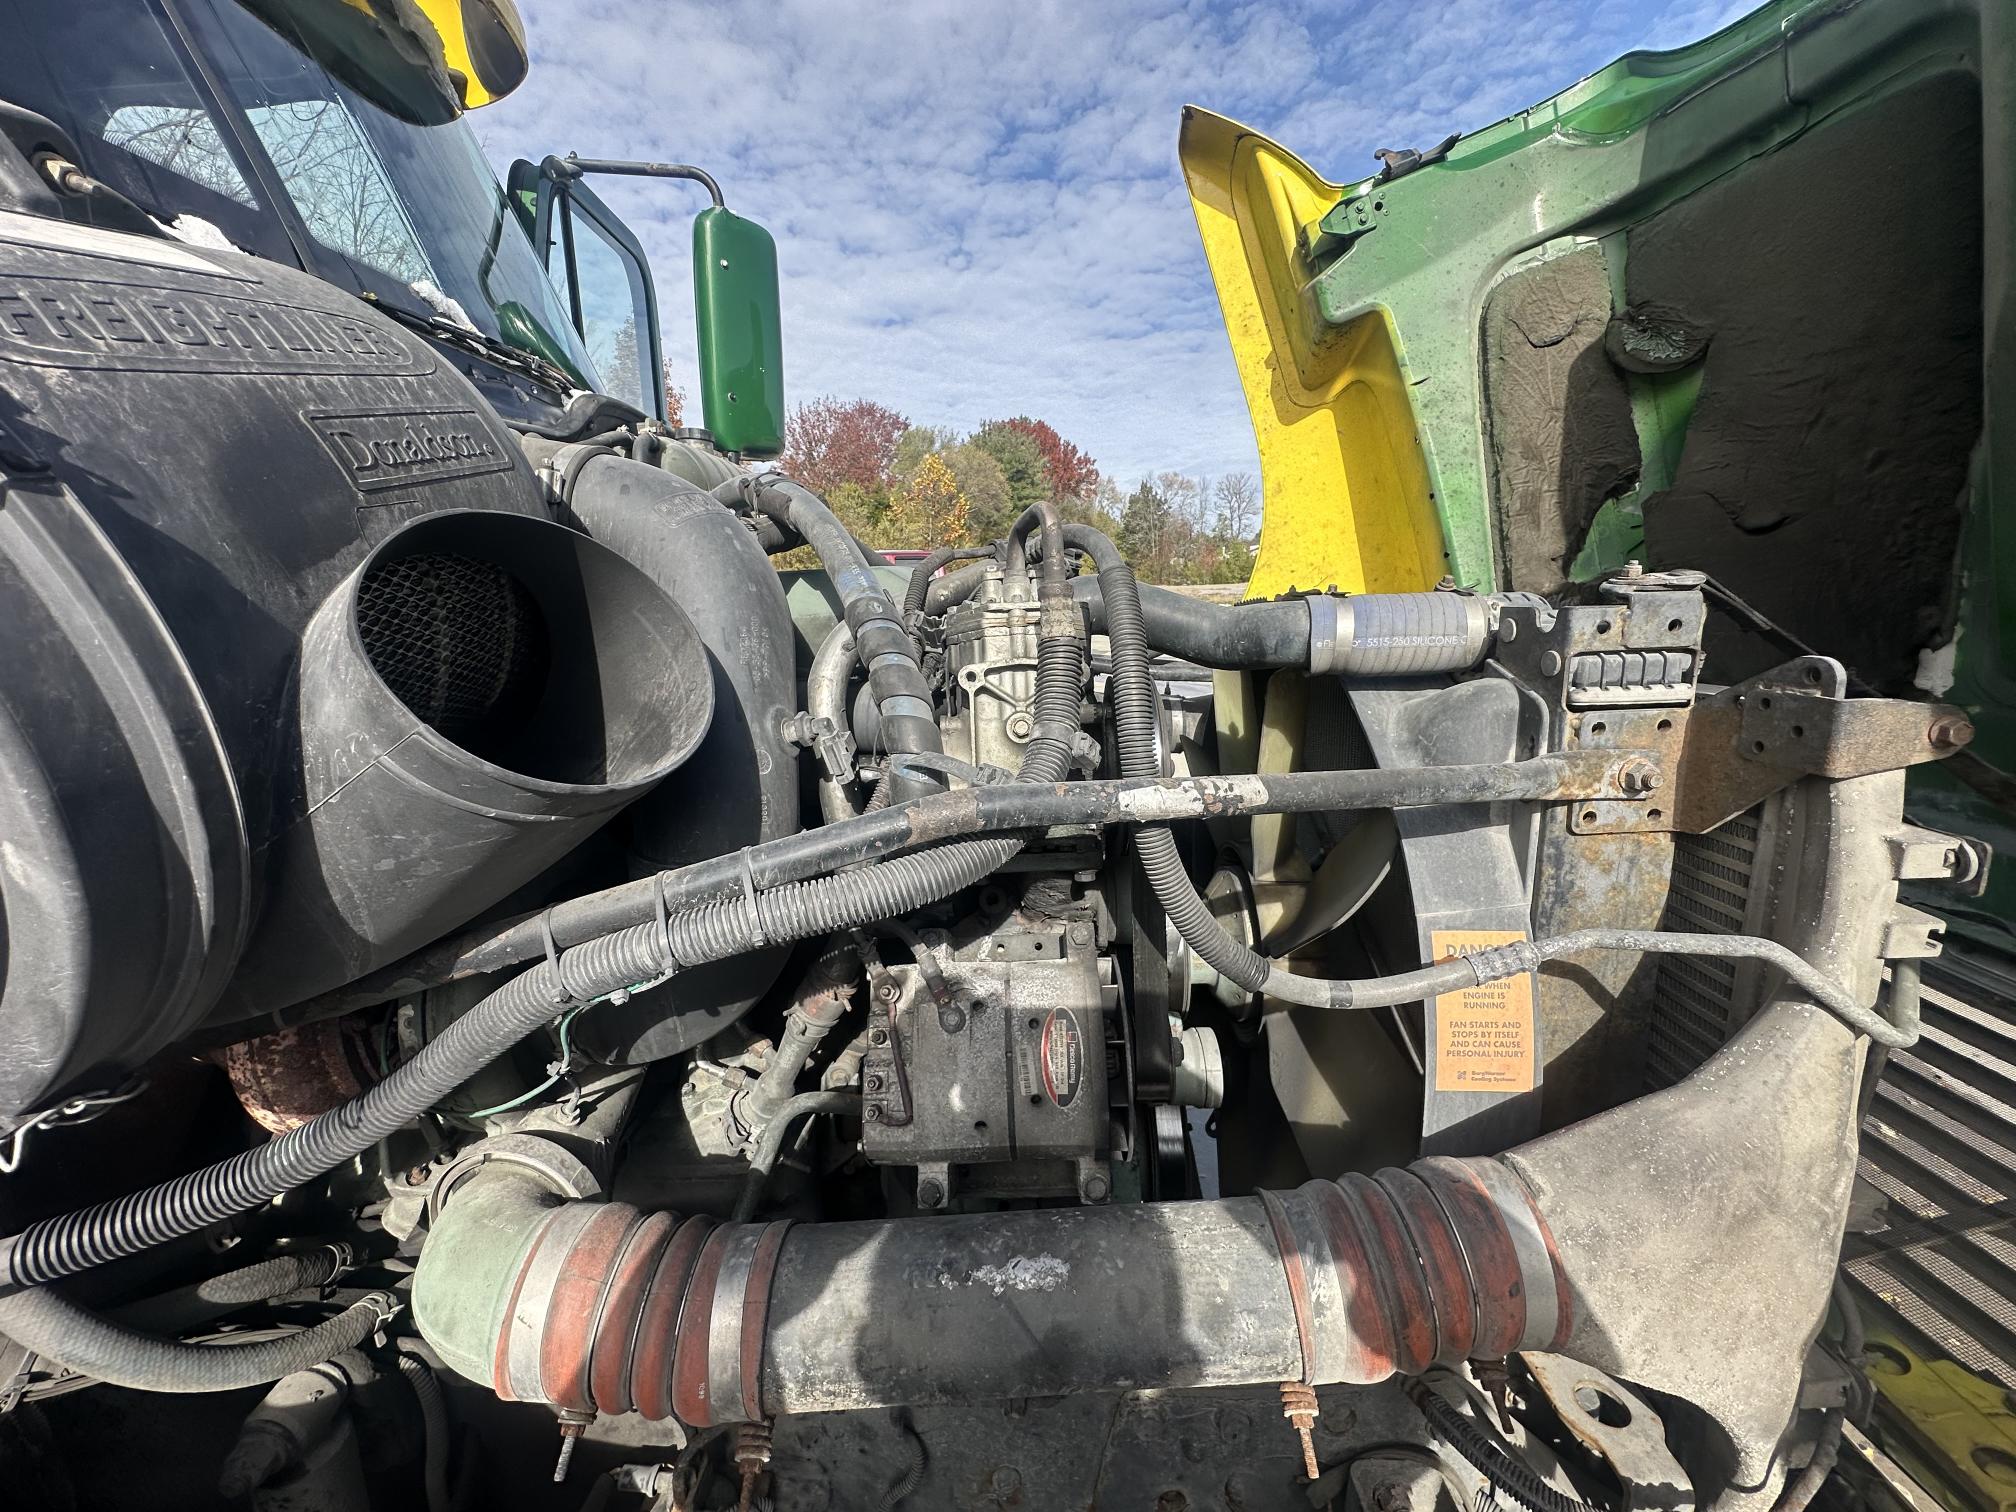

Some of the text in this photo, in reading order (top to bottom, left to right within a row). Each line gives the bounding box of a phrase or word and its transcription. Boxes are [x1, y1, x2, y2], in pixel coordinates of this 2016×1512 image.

[0, 293, 402, 357] FREIGHTLINER
[1412, 635, 1459, 646] SILICONE
[1484, 982, 1511, 990] WHEN
[1463, 992, 1506, 1000] ENGINE IS
[1463, 1001, 1506, 1009] RUNNING
[1449, 1021, 1522, 1029] FAN STARTS AND
[1451, 1030, 1520, 1039] STOPS BY ITSELF
[1450, 1040, 1521, 1048] AND CAN CAUSE
[1446, 1049, 1526, 1058] PERSONAL INJURY
